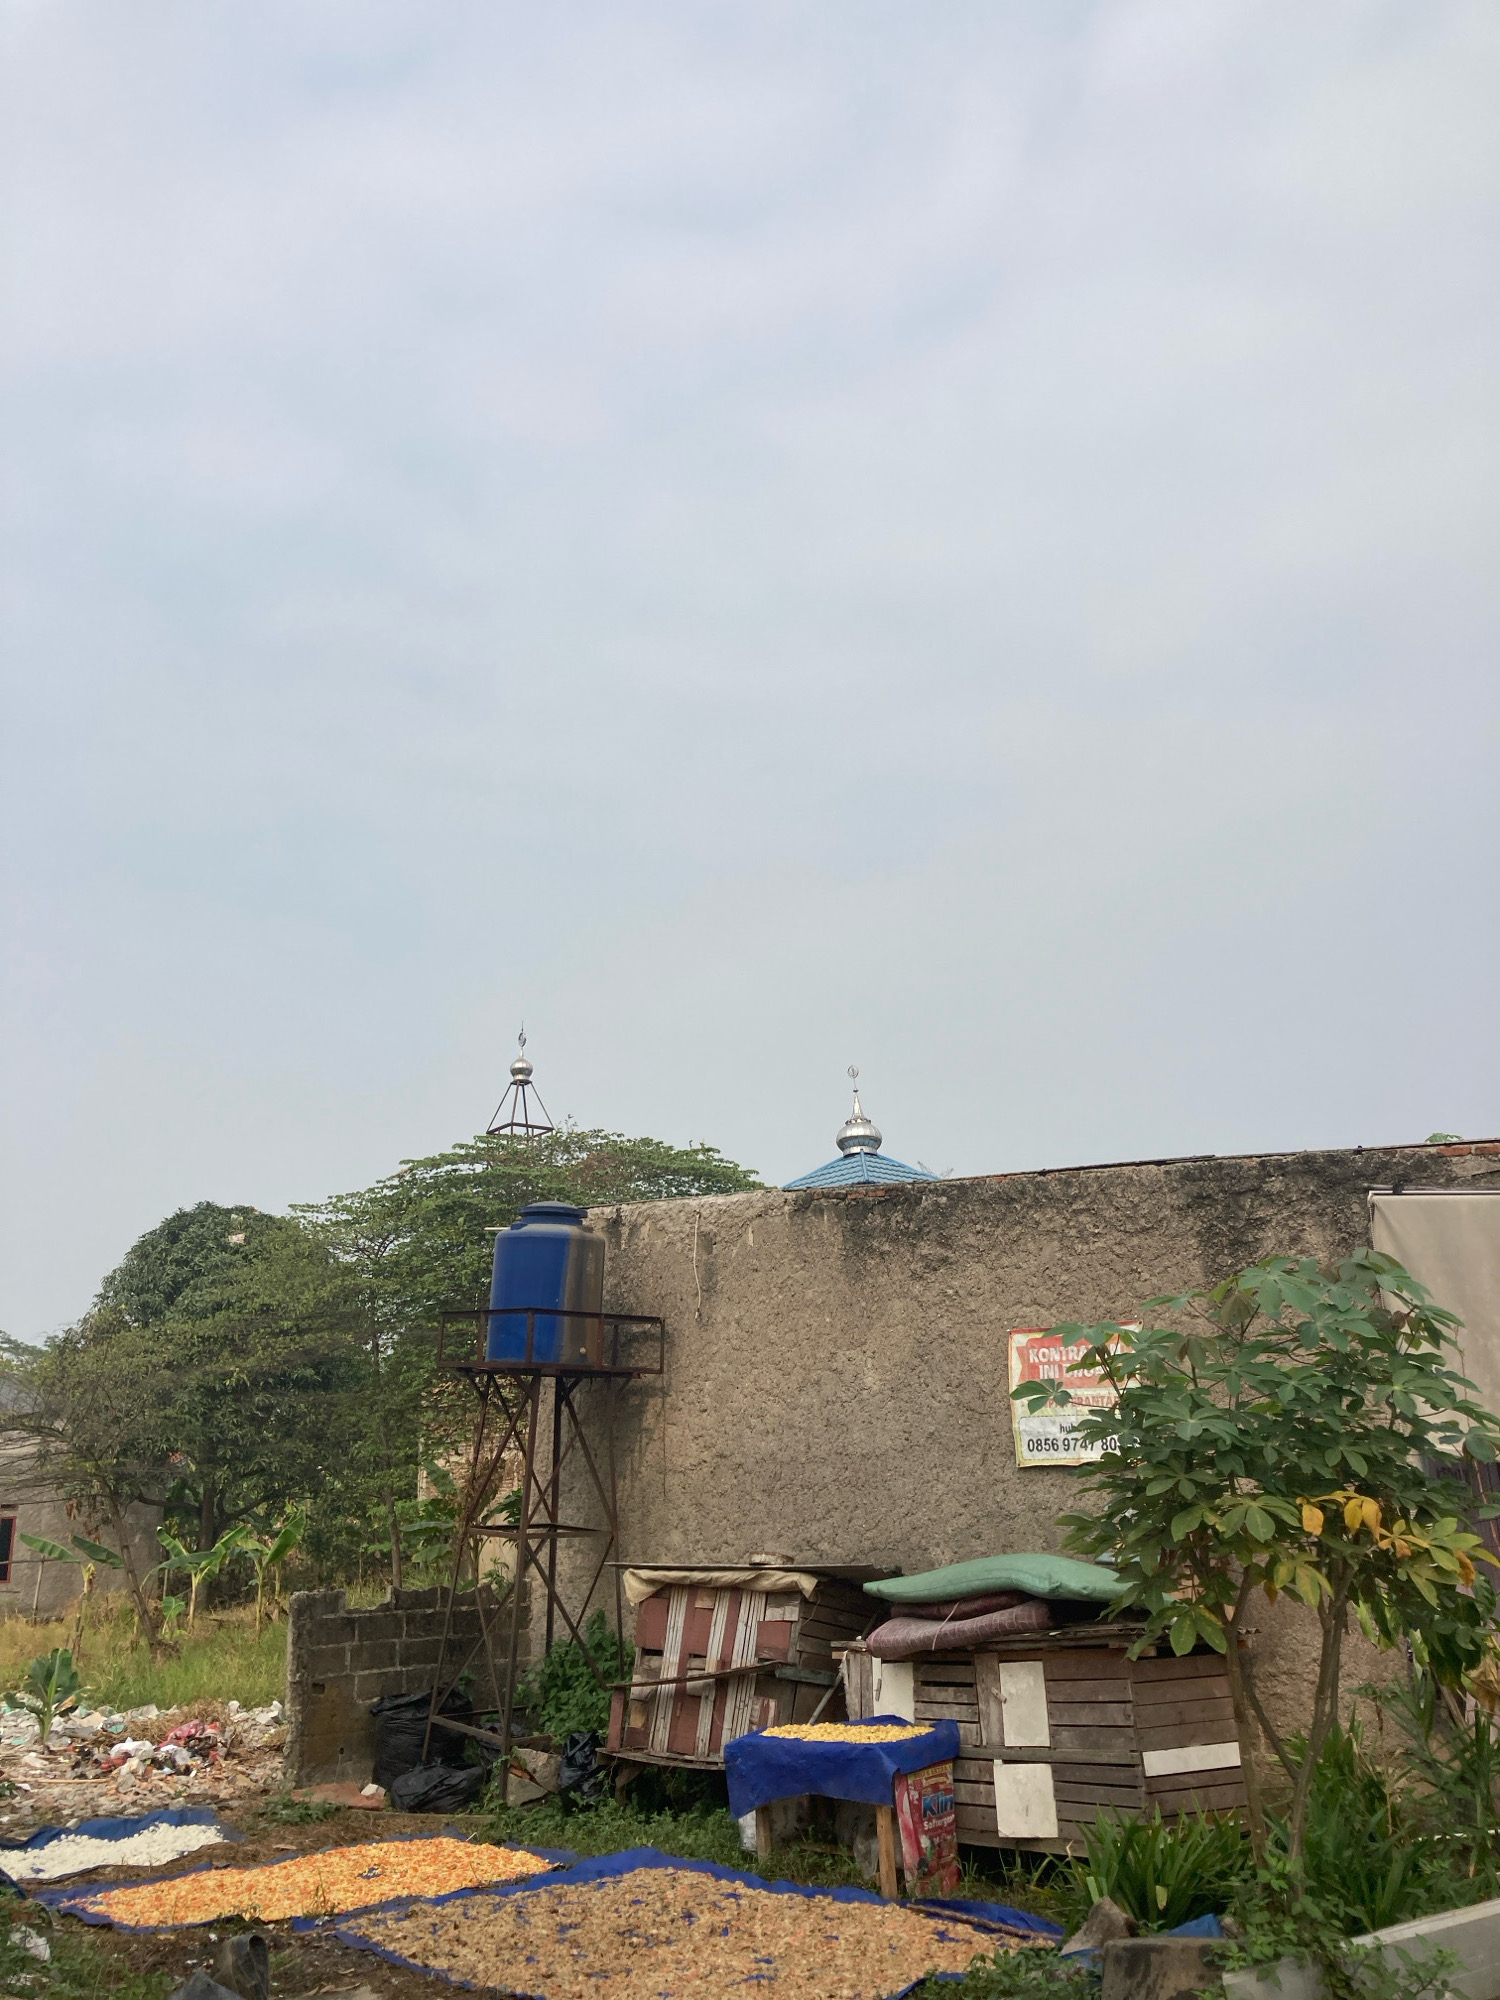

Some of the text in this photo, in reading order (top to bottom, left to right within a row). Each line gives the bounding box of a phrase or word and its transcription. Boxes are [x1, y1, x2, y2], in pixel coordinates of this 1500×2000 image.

[1039, 1364, 1060, 1379] INI
[1027, 1438, 1059, 1452] 0856
[922, 1791, 955, 1820] Klin
